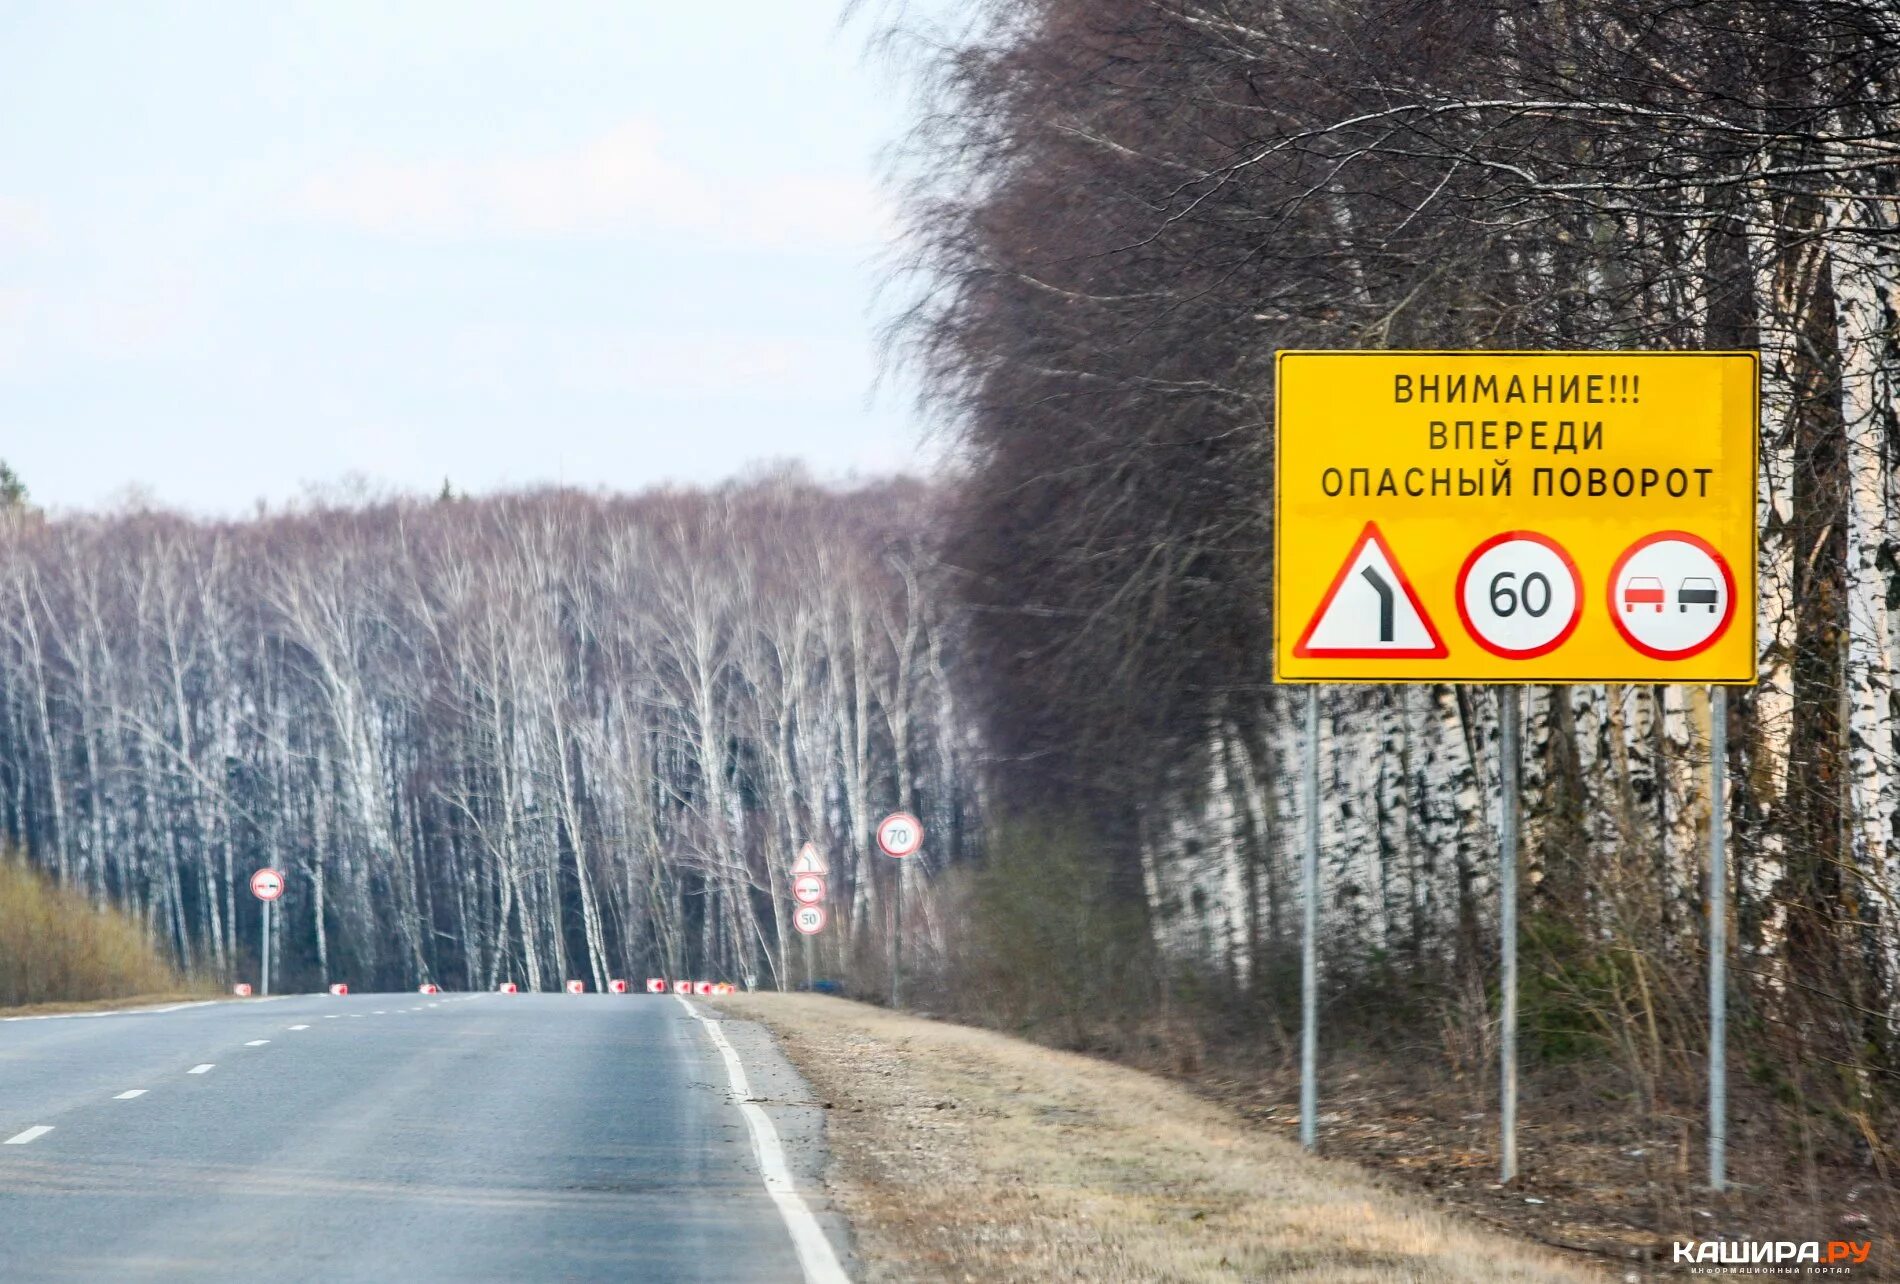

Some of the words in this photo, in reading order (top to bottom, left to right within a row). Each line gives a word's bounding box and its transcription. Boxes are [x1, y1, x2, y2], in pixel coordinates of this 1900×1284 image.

[1394, 374, 1640, 404] ВНИМАНИЕ!!!
[1429, 421, 1604, 454] ВПЕРЕДИ
[1321, 458, 1513, 497] ОПАСНЫЙ
[1533, 468, 1713, 497] ПОВОРОТ
[1489, 571, 1552, 618] 60
[887, 829, 907, 845] 70
[801, 914, 816, 926] 50
